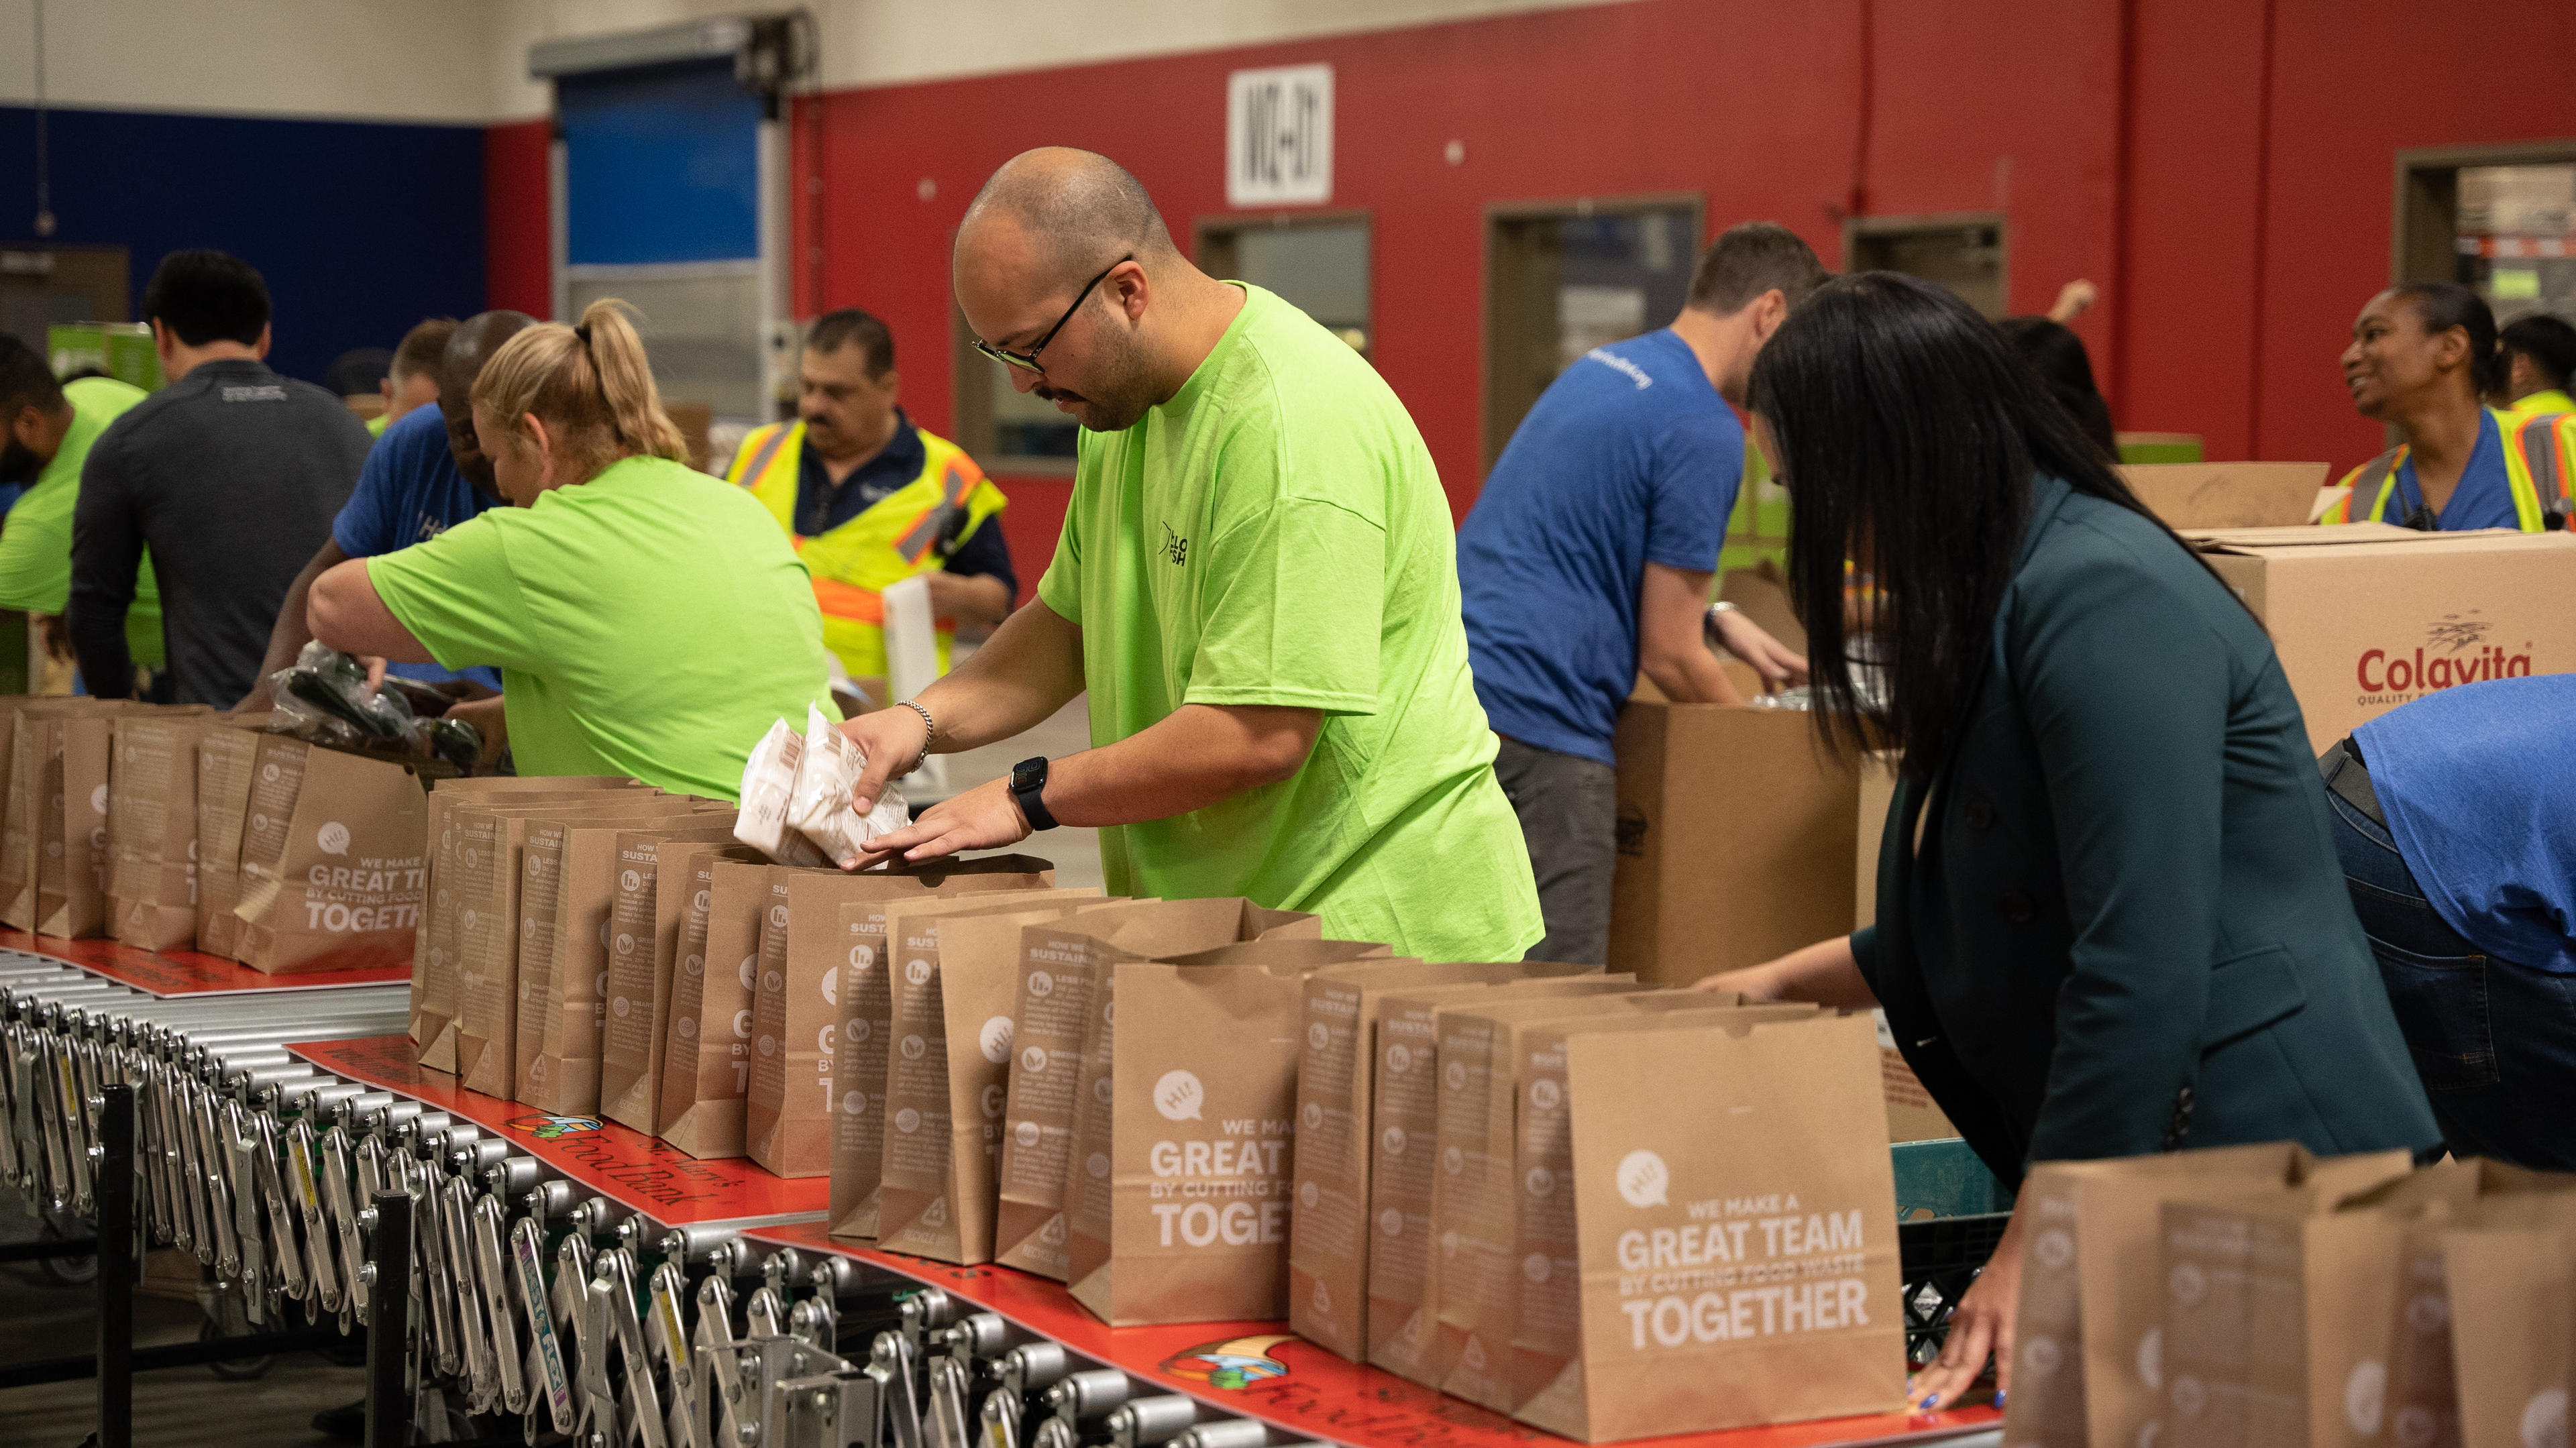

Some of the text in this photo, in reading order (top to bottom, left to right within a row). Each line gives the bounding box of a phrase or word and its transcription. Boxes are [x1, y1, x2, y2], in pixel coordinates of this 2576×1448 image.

[2357, 646, 2531, 692] Colavita
[2357, 693, 2412, 706] QUALITY
[539, 829, 552, 837] HOW
[637, 844, 655, 852] HOW
[360, 856, 421, 869] WE MAKE
[543, 857, 558, 865] LESS
[309, 864, 398, 891] GREAT
[306, 887, 324, 899] BY
[327, 889, 386, 904] CUTTING
[633, 1000, 653, 1008] SMART
[732, 1043, 751, 1056] BY
[1165, 1080, 1193, 1111] HI!
[1222, 1119, 1256, 1135] WE
[1150, 1140, 1286, 1177] GREAT
[544, 1135, 719, 1207] Food Bank
[1150, 1181, 1175, 1199] BY
[1182, 1180, 1269, 1197] CUTTING
[1686, 1192, 1800, 1219] WE MAKE A
[1617, 1209, 1864, 1272] GREAT TEAM
[1619, 1252, 1866, 1296] BY CUTTING FOOD WASTE
[1621, 1278, 1870, 1350] TOGETHER
[541, 1332, 564, 1390] FLEX
